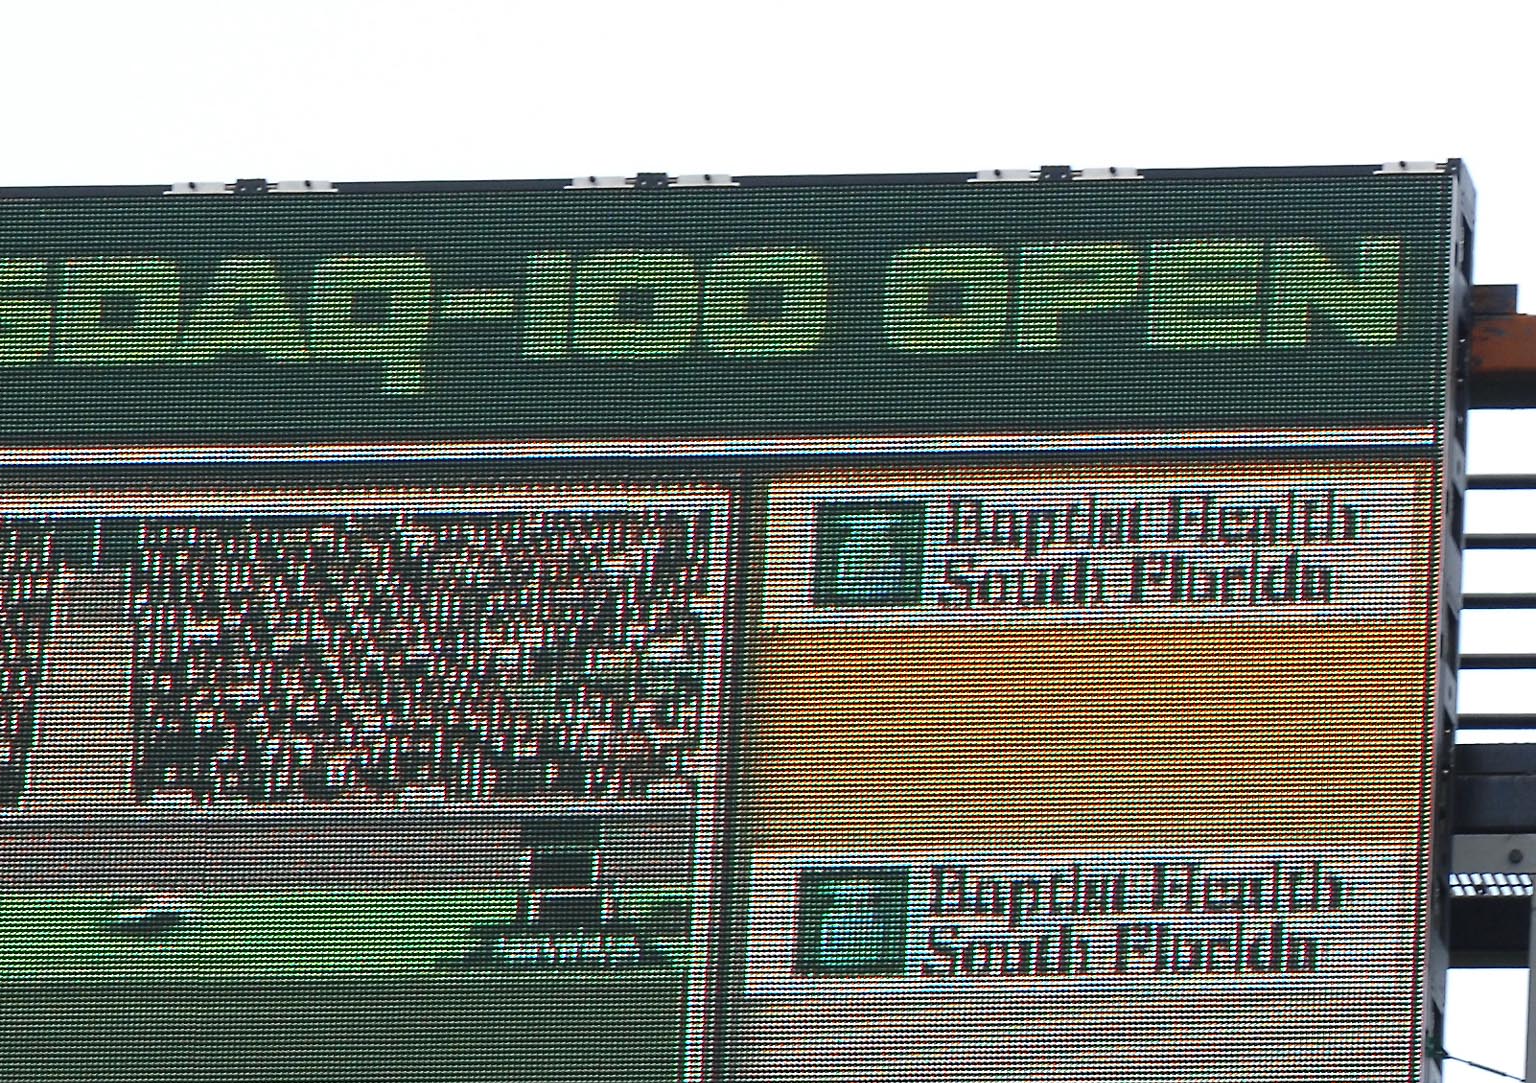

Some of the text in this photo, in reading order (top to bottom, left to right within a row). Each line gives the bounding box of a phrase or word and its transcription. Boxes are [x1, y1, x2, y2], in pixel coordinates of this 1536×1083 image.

[883, 236, 1402, 356] OPEN
[944, 489, 1358, 558] Baptist Health
[938, 550, 1335, 610] South Florida
[929, 859, 1344, 928] Baptist Health
[922, 921, 1318, 978] South Florida
